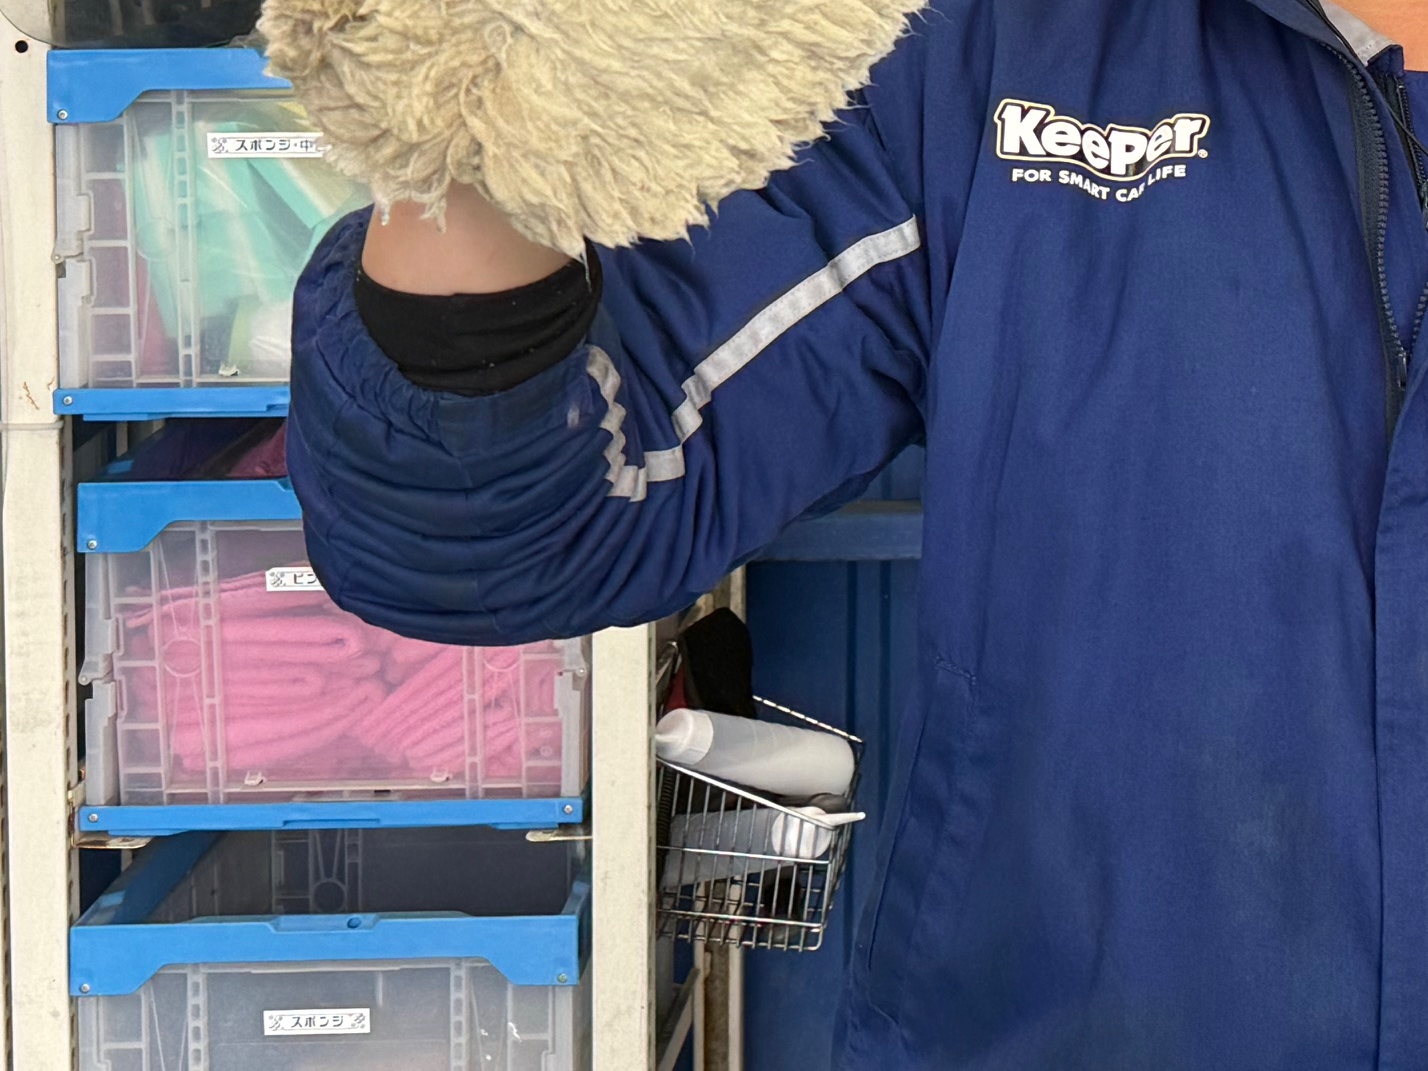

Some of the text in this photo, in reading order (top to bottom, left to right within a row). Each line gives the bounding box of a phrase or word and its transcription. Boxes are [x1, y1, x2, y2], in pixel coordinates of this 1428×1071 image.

[1011, 168, 1052, 182] FOR
[1058, 169, 1111, 201] SMART
[1147, 164, 1187, 186] LIFE
[291, 1015, 344, 1028] スポンジ
